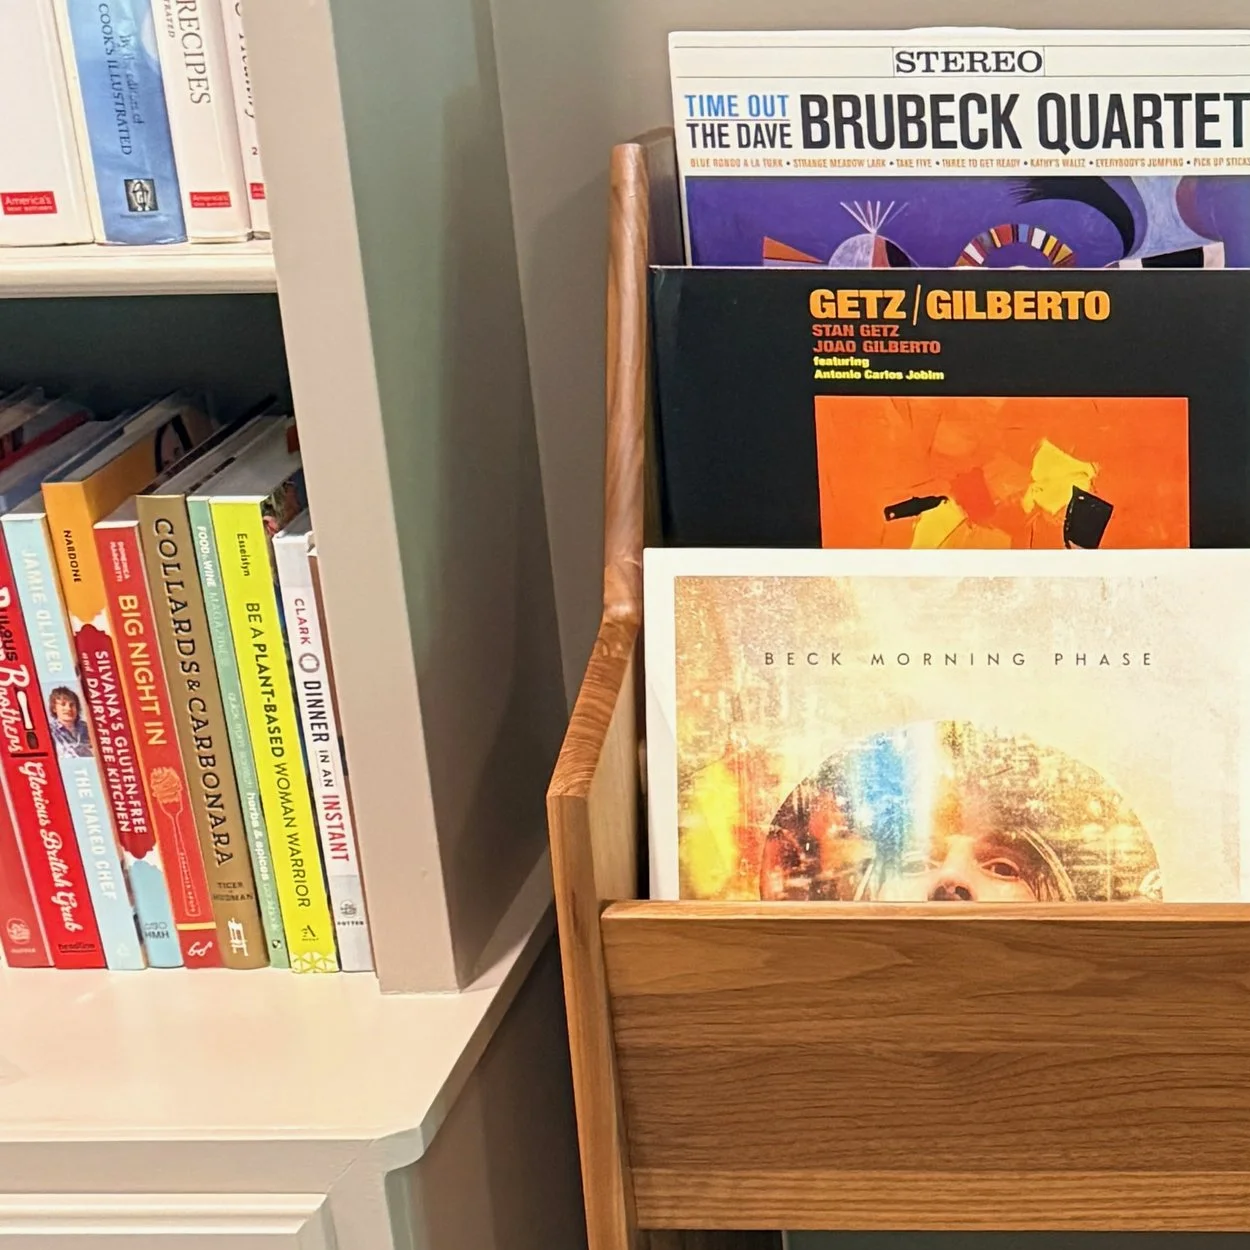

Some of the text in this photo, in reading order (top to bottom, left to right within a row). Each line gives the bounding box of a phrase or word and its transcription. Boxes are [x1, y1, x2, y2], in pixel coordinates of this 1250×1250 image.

[98, 2, 132, 156] COOK'S ILLUSTRATED
[175, 0, 211, 105] RECIPES
[895, 50, 1043, 73] STEREO
[684, 94, 789, 117] TIME OUT
[686, 123, 730, 149] THE
[737, 123, 792, 149] DAVE
[800, 92, 1022, 150] BRUBECK
[867, 158, 886, 168] LARK
[896, 158, 914, 168] TAKE
[915, 158, 932, 168] FIVE
[942, 158, 966, 168] THREE
[968, 158, 978, 168] TO
[980, 158, 994, 168] GET
[1193, 158, 1212, 168] PICK
[1214, 158, 1225, 168] UP
[812, 324, 900, 337] STAN GETZ
[813, 340, 941, 354] JOAO GILBERTO
[813, 356, 869, 368] featuring
[814, 369, 945, 381] Antonio Carlos Jobim
[22, 551, 46, 604] JAMIE
[155, 518, 200, 674] COLLARDS
[294, 598, 312, 645] CLARK
[118, 595, 167, 745] BIG NIGHT IN
[187, 679, 200, 691] &
[765, 652, 1152, 666] BECK MORNING PHASE
[304, 680, 330, 743] DINNER
[86, 678, 116, 764] DAIRY-FREE
[105, 767, 131, 833] KITCHEN
[95, 651, 147, 834] SILVANA'S GLUTEN-FREE
[246, 602, 310, 908] BE A PLANT-BASED WOMAN WARRIOR
[318, 750, 334, 788] IN AN
[188, 697, 233, 866] CARBONARA
[19, 761, 84, 932] Glorious British Grub
[74, 768, 116, 900] THE NAKED CHEF
[322, 794, 349, 862] INSTANT
